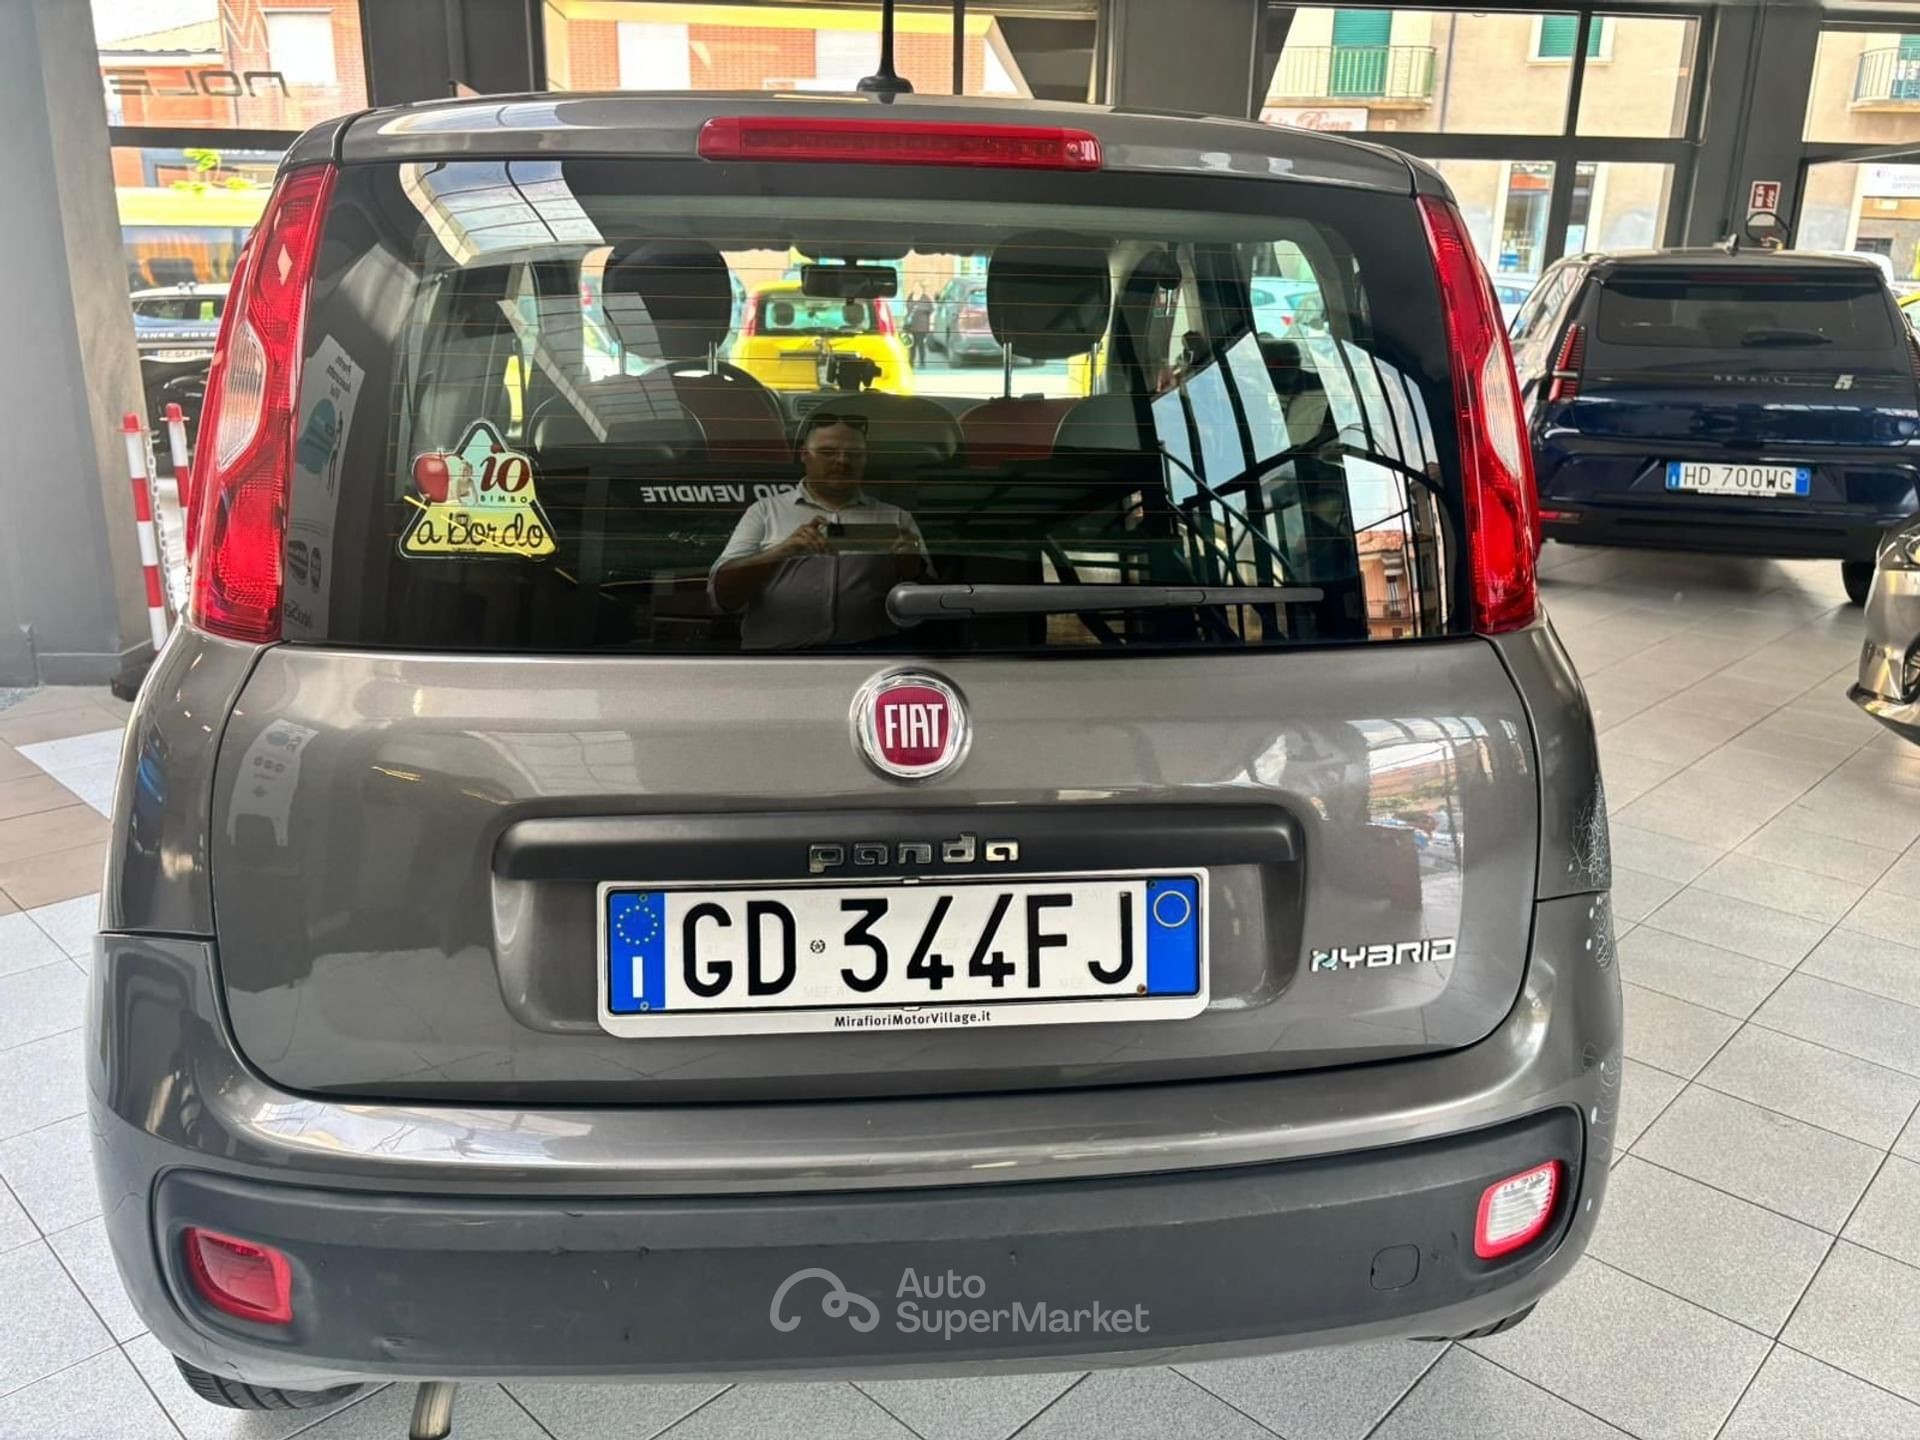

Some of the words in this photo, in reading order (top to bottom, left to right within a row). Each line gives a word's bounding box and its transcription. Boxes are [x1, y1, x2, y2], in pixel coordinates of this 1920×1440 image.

[1713, 374, 1790, 384] RENAULT
[1684, 465, 1711, 486] HD
[1721, 467, 1792, 490] 700WG
[884, 703, 943, 749] FIAT
[808, 832, 1019, 873] panda
[682, 901, 797, 998] GD
[840, 891, 1133, 994] 344FJ
[1311, 938, 1456, 972] HYBRID
[834, 1010, 990, 1028] MirafioriMotorVillage.it
